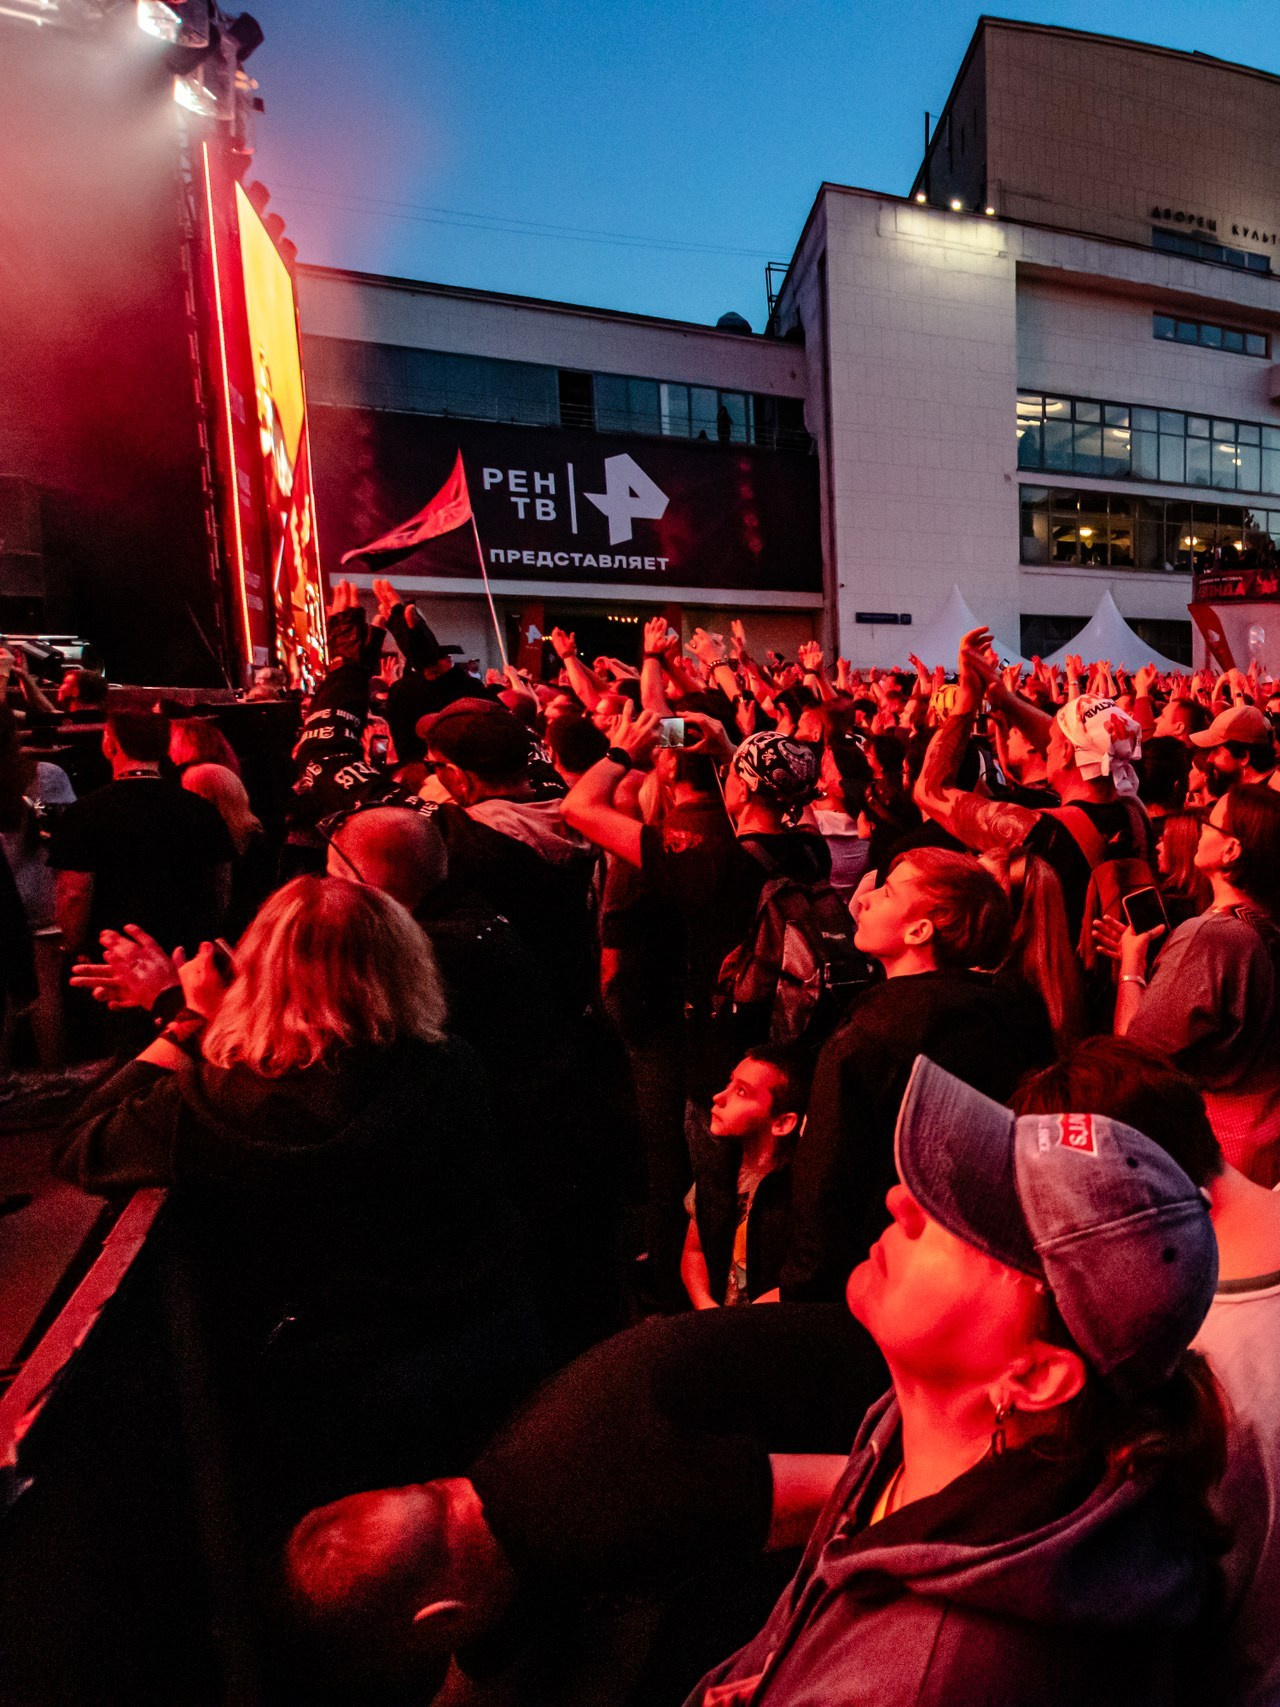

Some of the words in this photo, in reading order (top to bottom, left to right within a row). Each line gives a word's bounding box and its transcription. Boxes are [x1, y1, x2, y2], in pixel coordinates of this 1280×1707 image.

[1151, 206, 1217, 232] ДВОРЕЦ
[482, 467, 556, 495] РЕН
[510, 497, 557, 521] ТВ
[489, 549, 670, 571] ПРЕДСТАВЛЯЕТ
